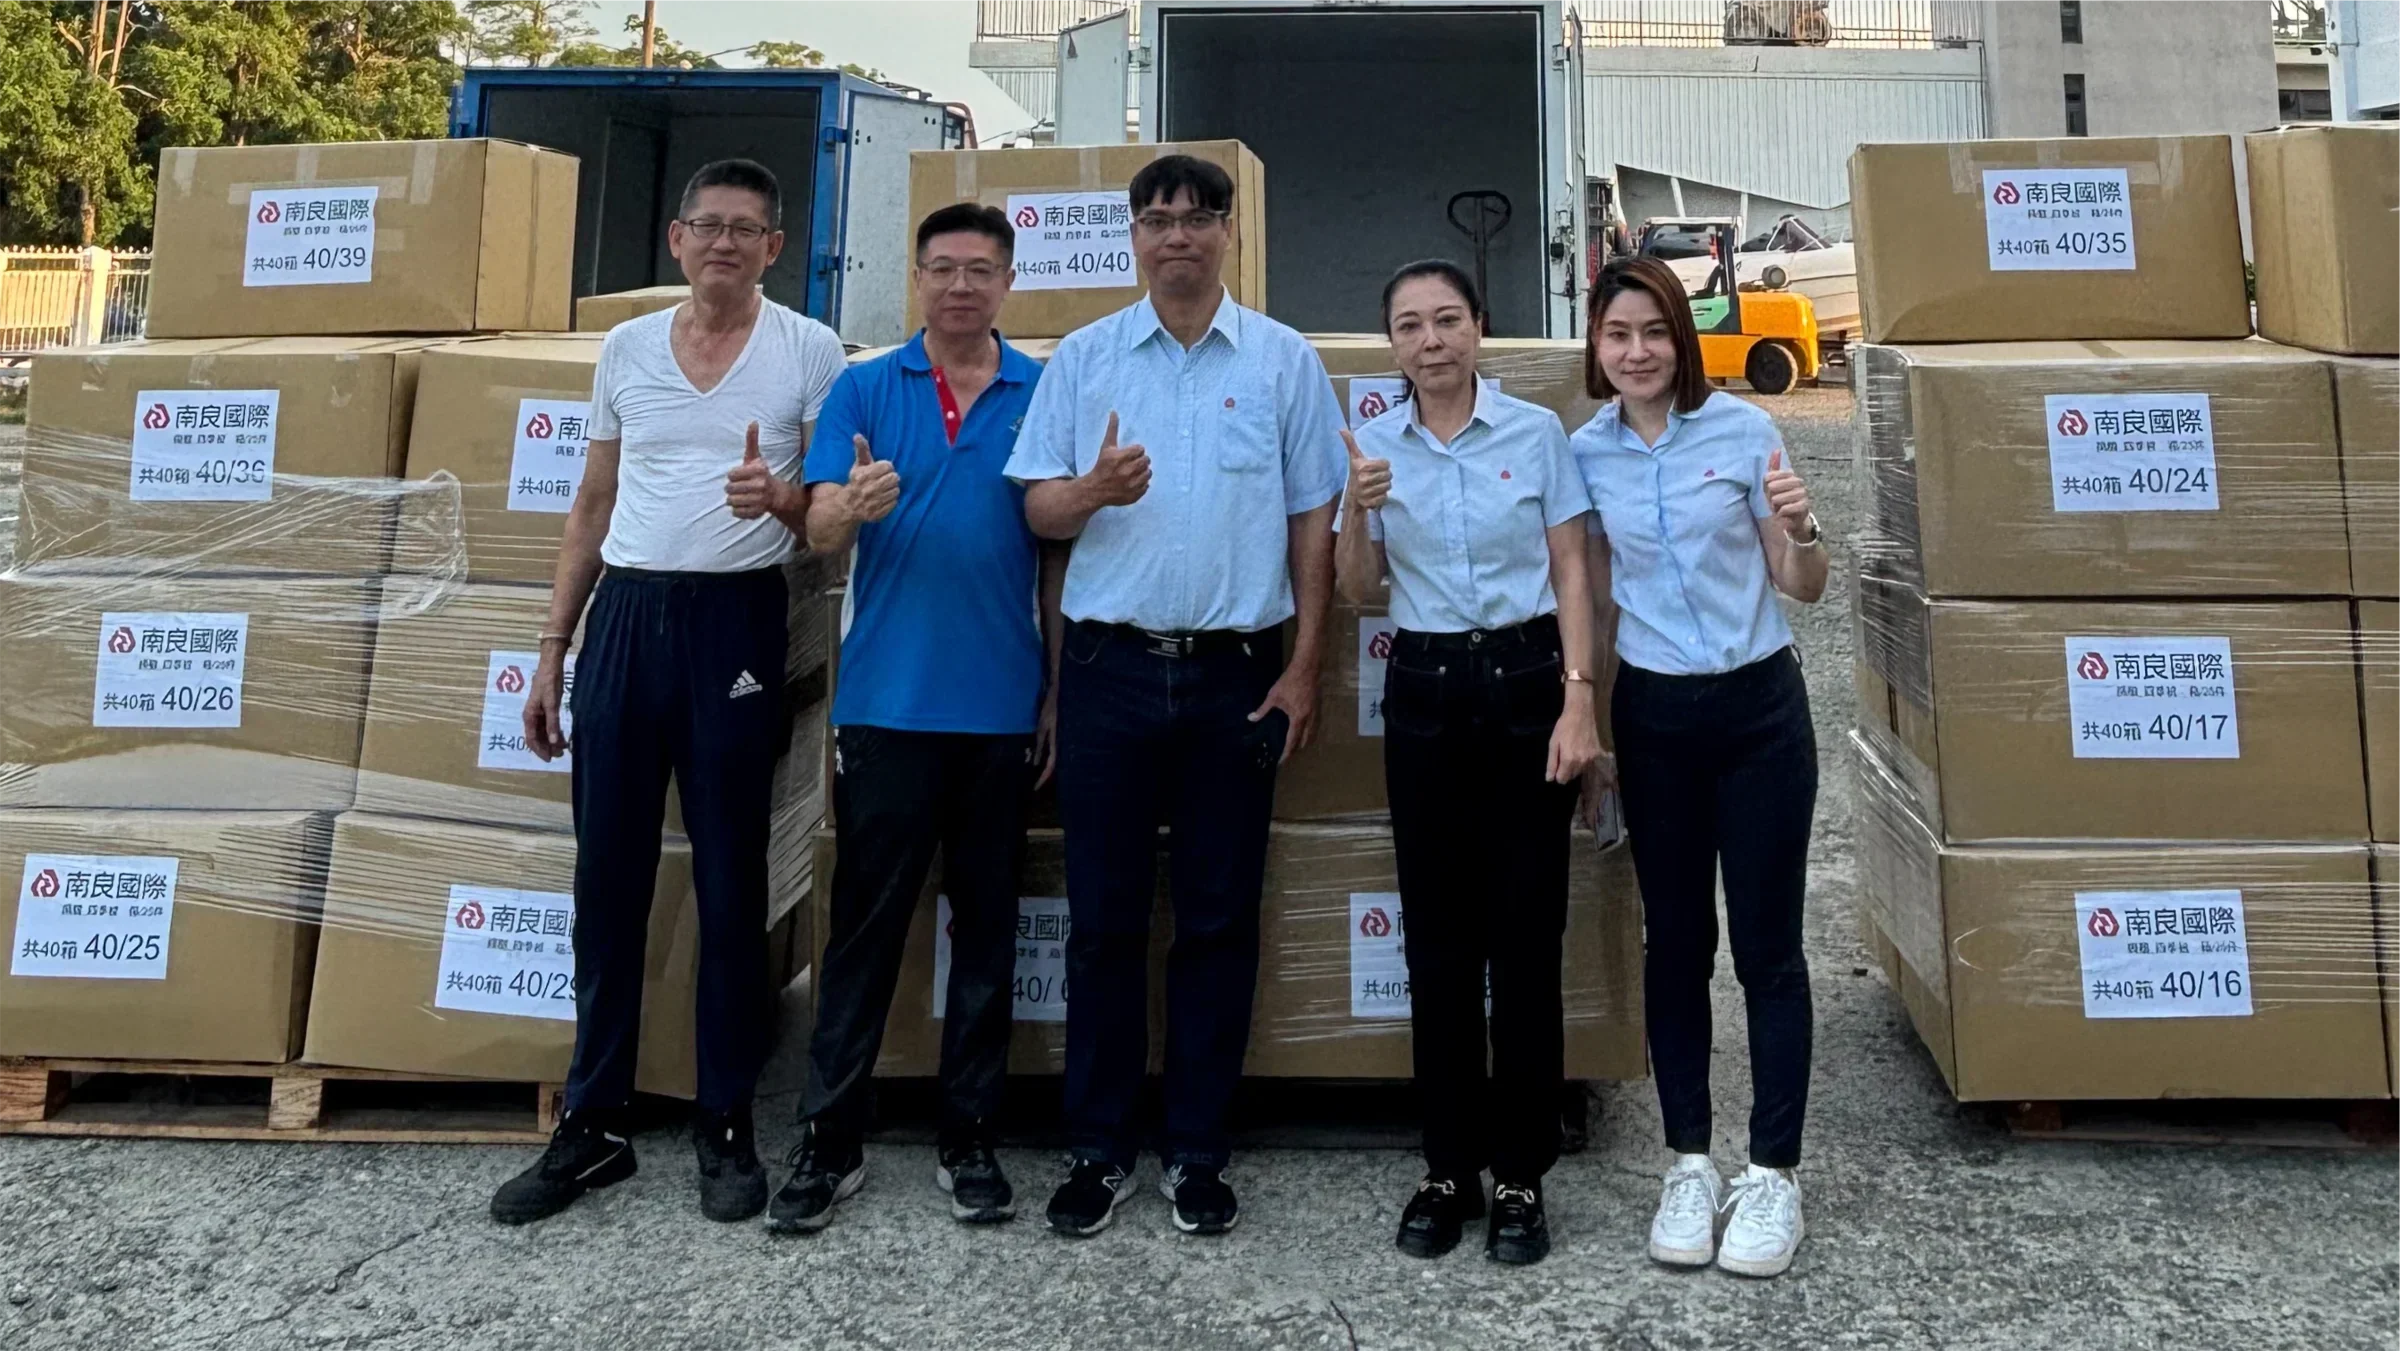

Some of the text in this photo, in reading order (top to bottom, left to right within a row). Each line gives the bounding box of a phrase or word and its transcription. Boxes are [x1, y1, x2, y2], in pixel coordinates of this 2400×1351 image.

[2025, 181, 2122, 204] 南良國際
[285, 199, 370, 222] 南良國際
[1044, 204, 1129, 226] 南良國際
[2055, 232, 2127, 255] 40/35
[302, 247, 366, 269] 40/39
[1066, 251, 1130, 273] 40/40
[175, 404, 270, 429] 南良國際
[2093, 409, 2204, 435] 南良國際
[195, 459, 266, 484] 40/36
[2061, 467, 2209, 495] 共40箱 40/24
[516, 476, 571, 497] 共40箱
[141, 628, 239, 654] 南良國際
[2113, 653, 2225, 680] 南良國際
[161, 686, 234, 712] 40/26
[2148, 713, 2228, 741] 40/17
[488, 733, 532, 754] 共40
[65, 871, 166, 900] 南良國際
[490, 904, 576, 938] 南良國
[2125, 907, 2236, 936] 南良國際
[83, 933, 161, 961] 40/25
[446, 970, 503, 995] 共40箱
[2160, 970, 2242, 999] 40/16
